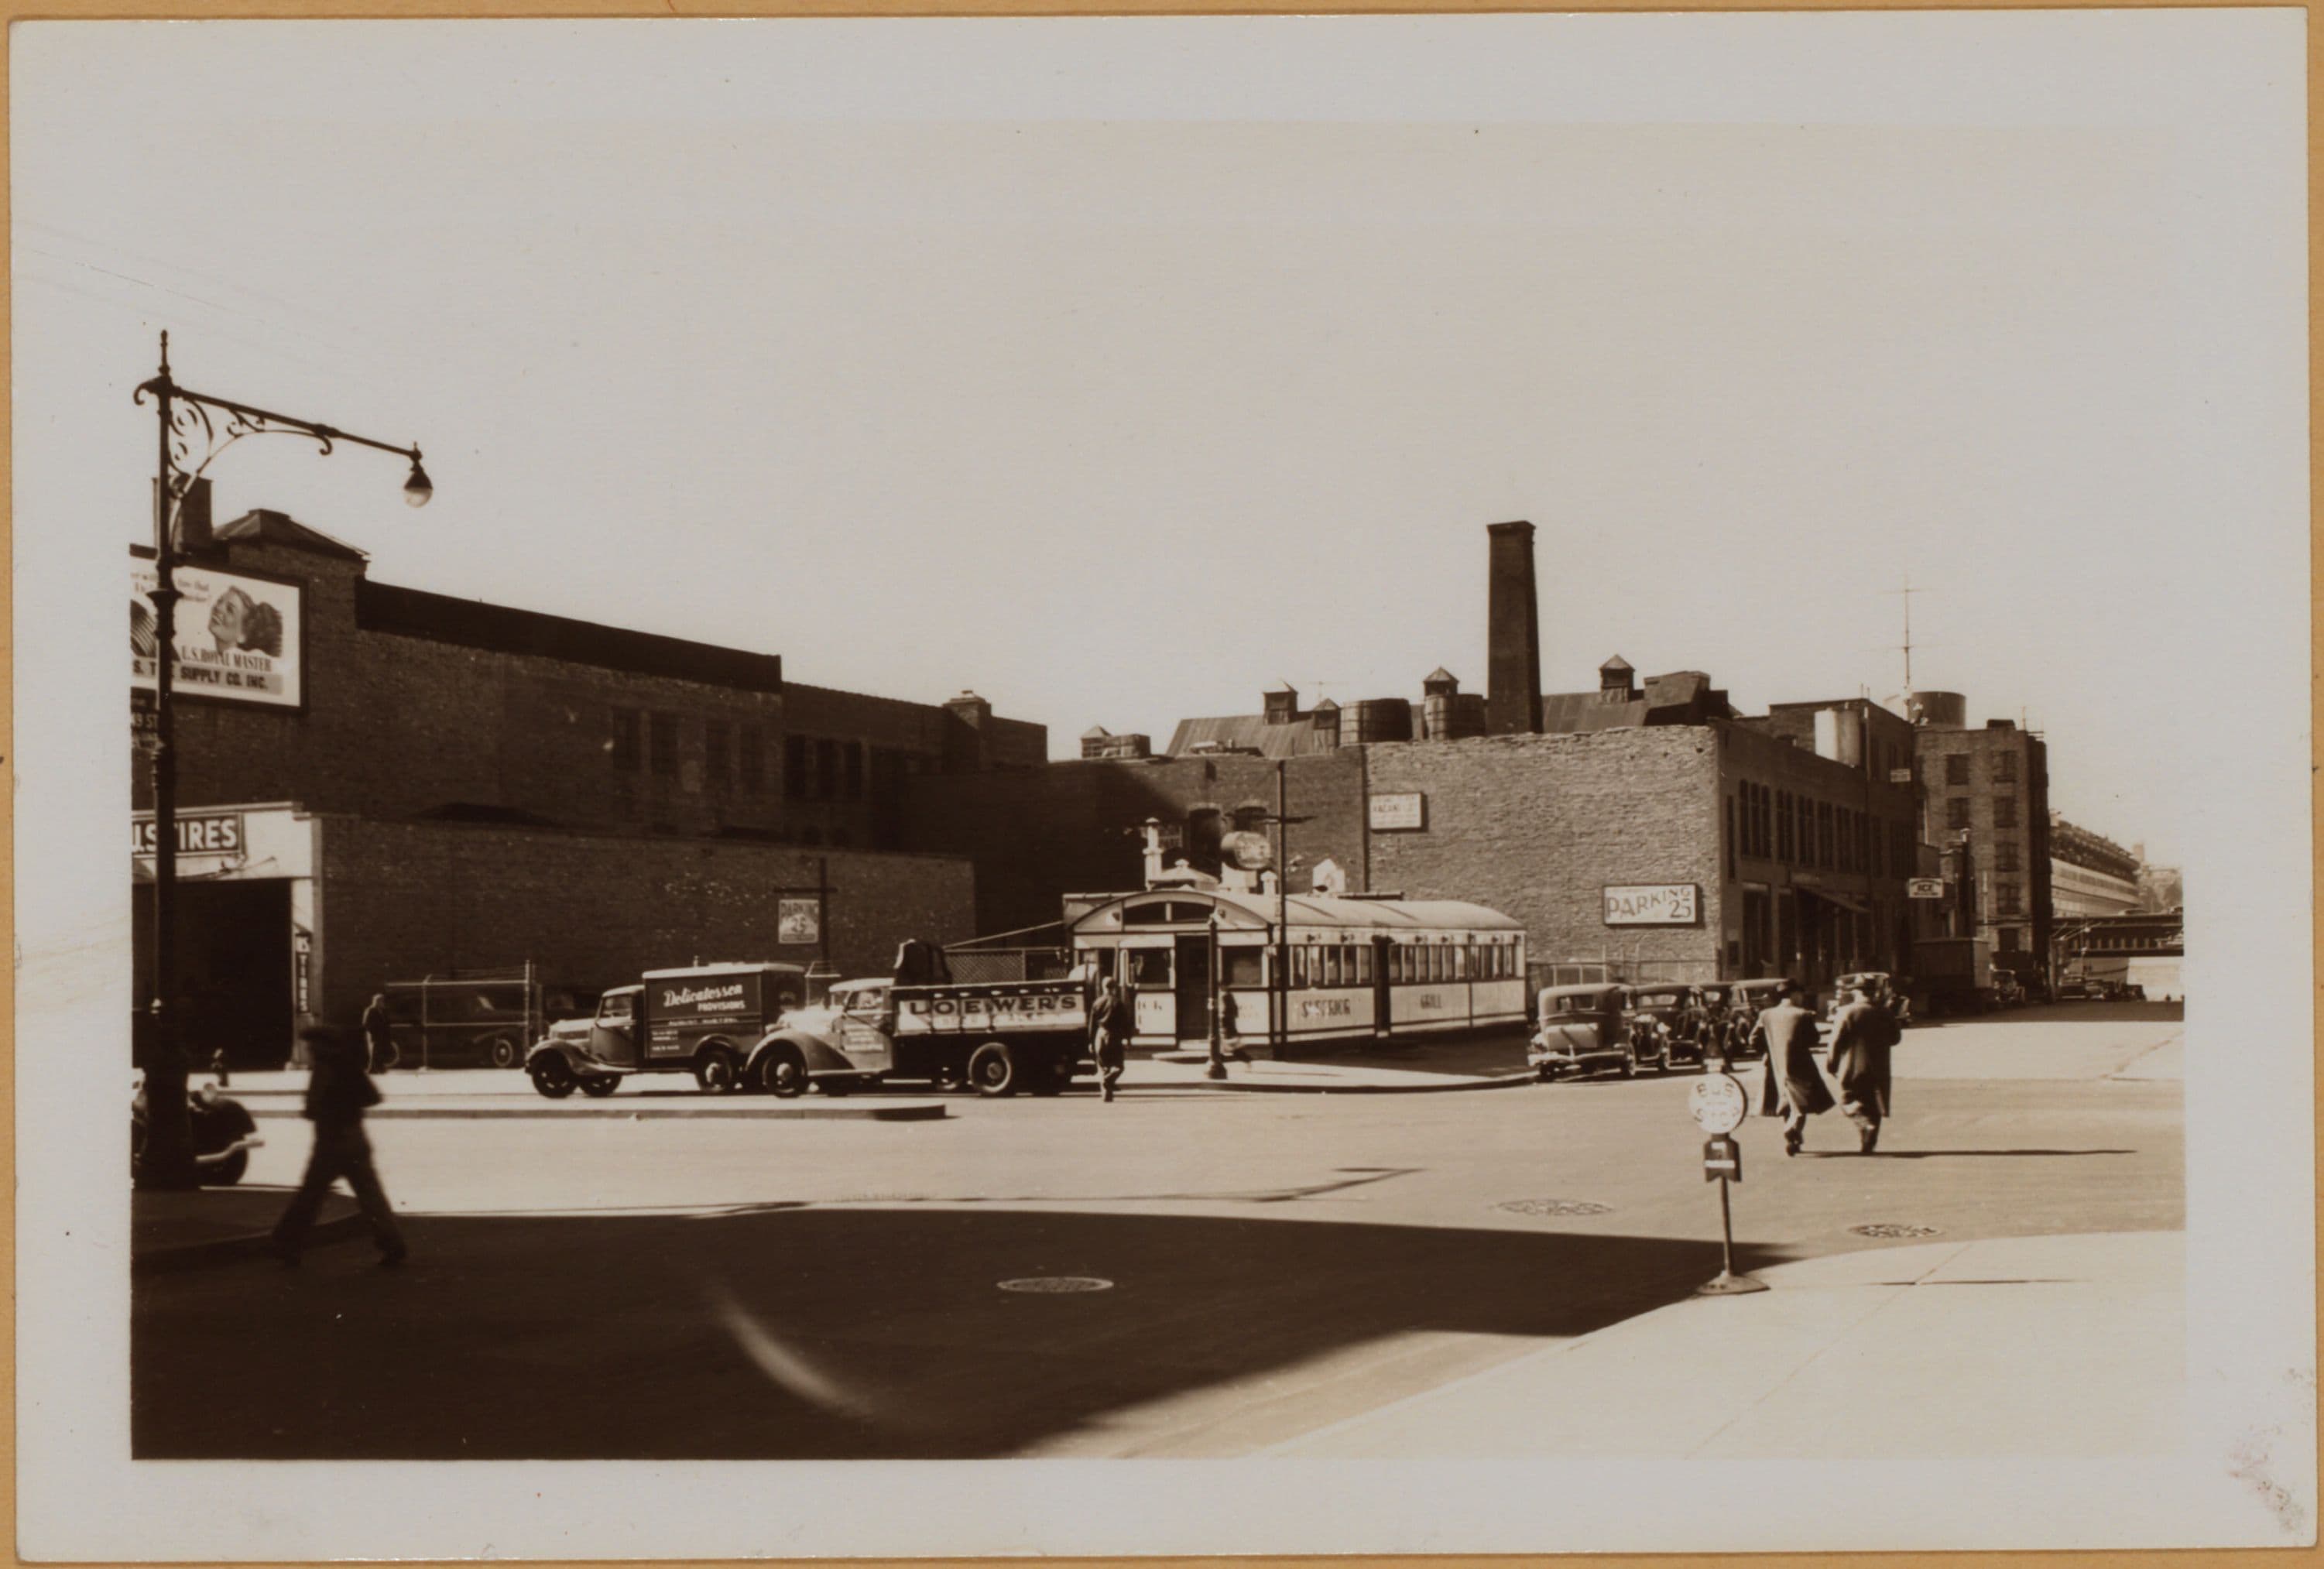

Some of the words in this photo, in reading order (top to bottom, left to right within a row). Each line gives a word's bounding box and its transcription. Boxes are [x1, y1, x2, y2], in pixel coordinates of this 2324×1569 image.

[234, 653, 273, 672] MASTER
[180, 666, 221, 683] SUPPLY
[226, 672, 242, 687] CO.
[246, 674, 269, 690] INC.
[173, 819, 237, 851] IRES
[1607, 887, 1691, 918] PARKING
[1669, 898, 1692, 919] 25
[663, 984, 743, 1007] Delicatessen
[698, 1000, 746, 1012] PROVISIONS
[910, 996, 1077, 1015] LOEWER'S
[1696, 1083, 1734, 1098] BUS
